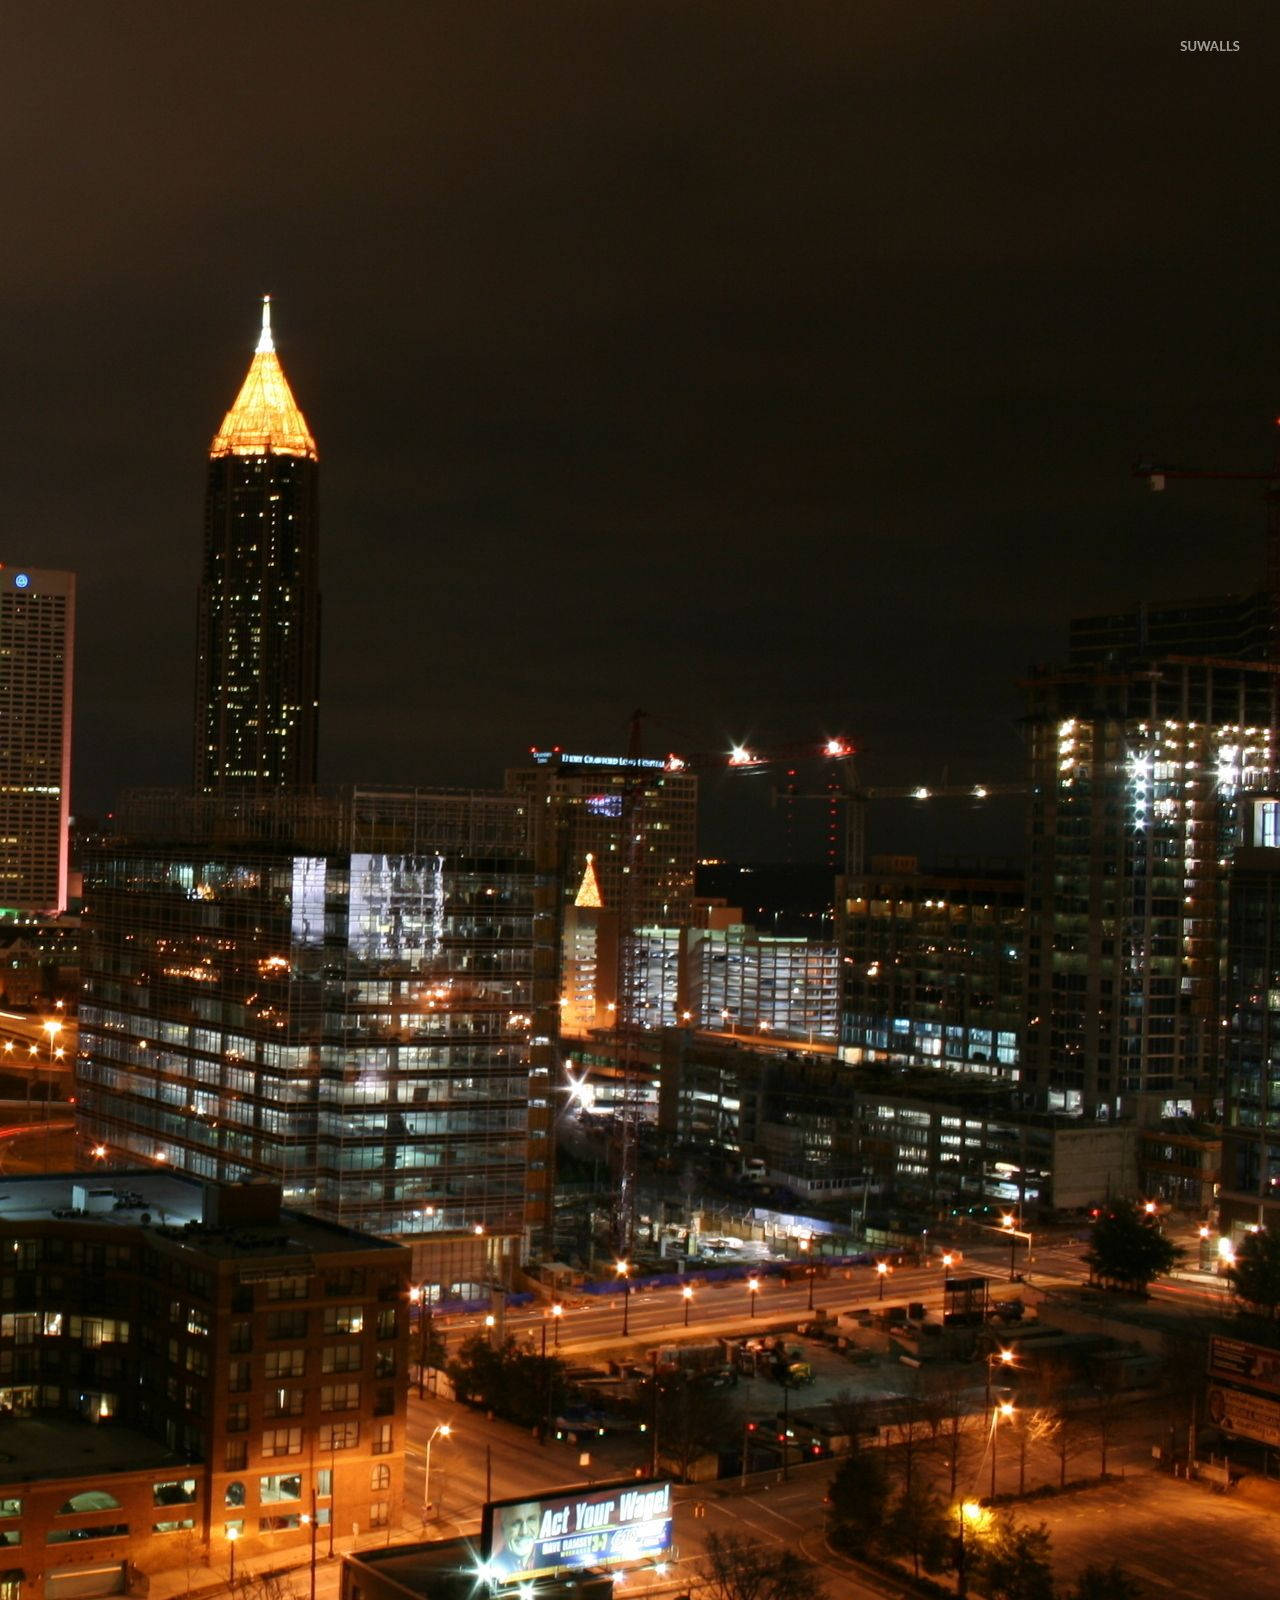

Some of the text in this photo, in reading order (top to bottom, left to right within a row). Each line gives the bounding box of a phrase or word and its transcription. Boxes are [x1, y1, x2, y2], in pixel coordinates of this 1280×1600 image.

[539, 1506, 570, 1539] Act
[575, 1501, 615, 1531] Your
[619, 1484, 670, 1522] Wage!
